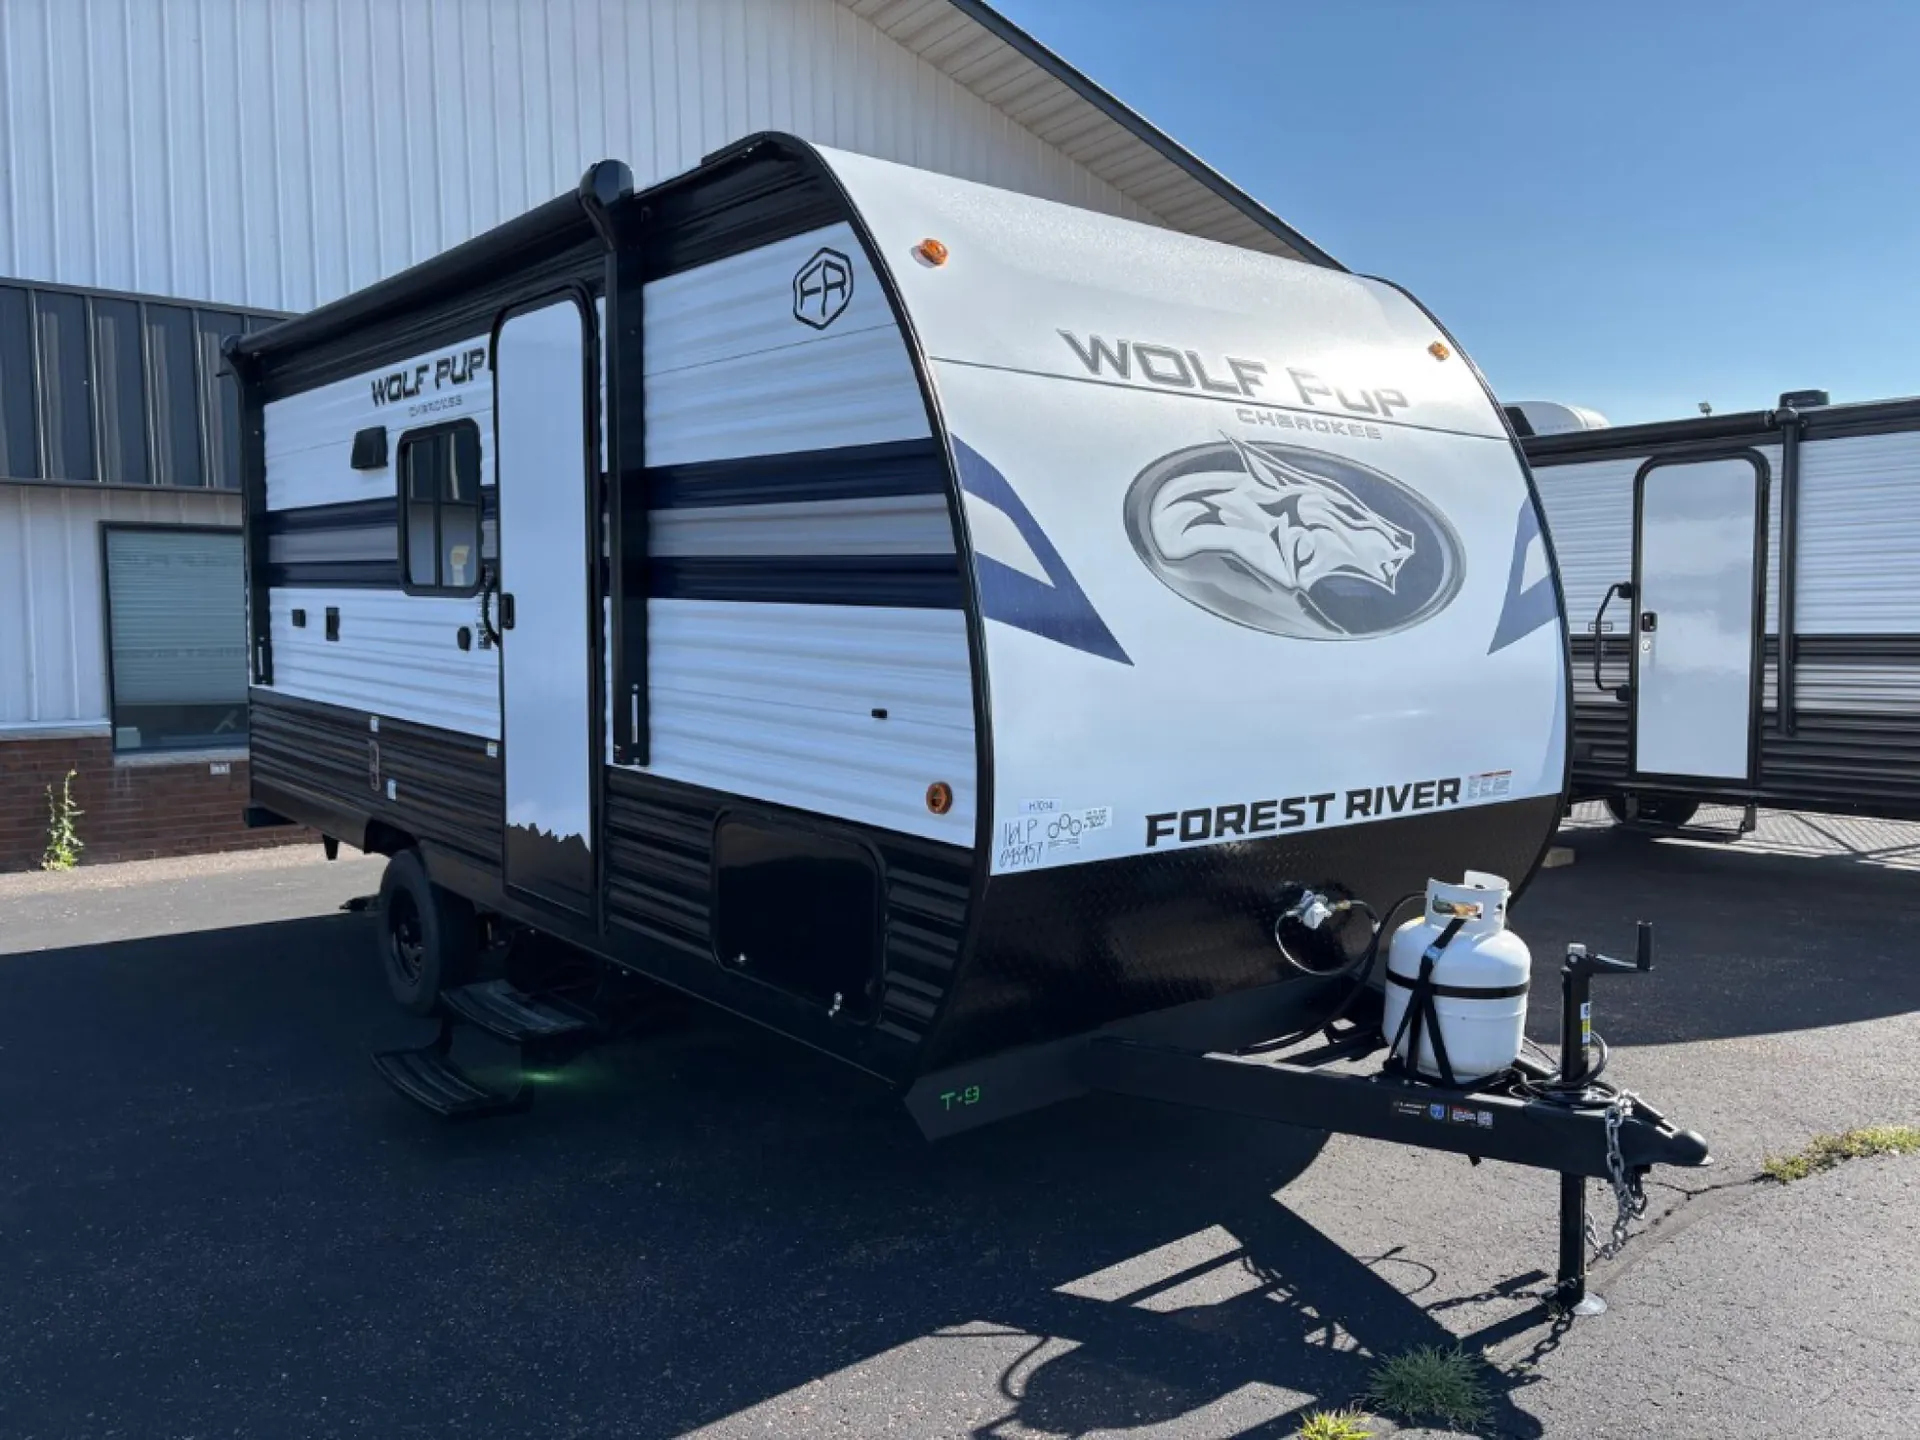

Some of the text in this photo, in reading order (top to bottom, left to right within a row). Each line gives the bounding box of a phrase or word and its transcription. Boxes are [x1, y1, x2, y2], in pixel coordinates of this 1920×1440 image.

[371, 347, 485, 408] WOLF PUP
[1056, 327, 1411, 418] WOLF PUP
[1235, 407, 1383, 441] CHEROKEE
[1145, 791, 1336, 848] FOREST
[1345, 777, 1462, 820] RIVER
